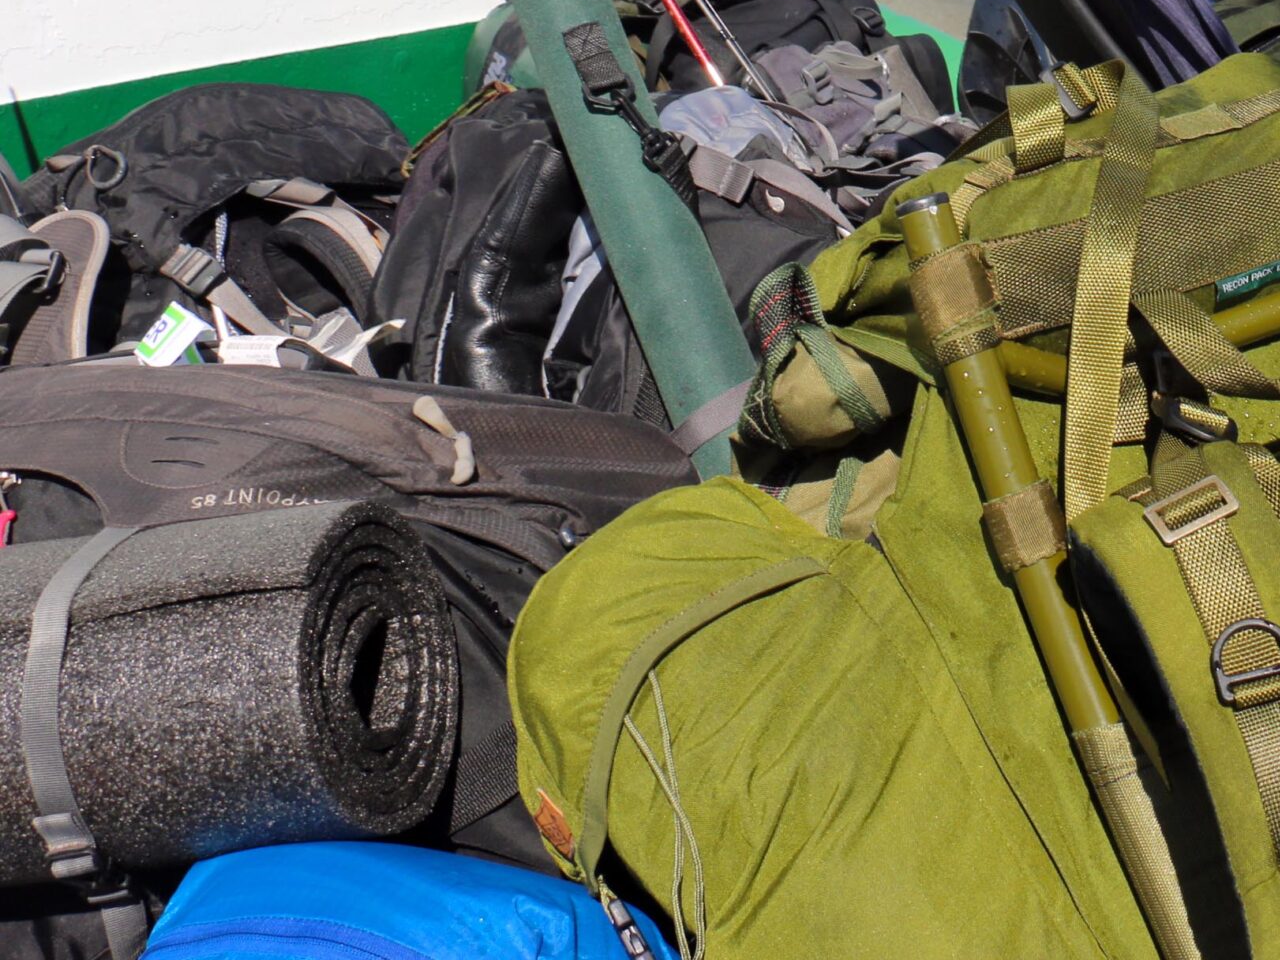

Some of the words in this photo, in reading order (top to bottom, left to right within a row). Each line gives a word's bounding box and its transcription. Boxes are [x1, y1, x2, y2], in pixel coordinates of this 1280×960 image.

[1222, 275, 1250, 294] RECON
[1251, 266, 1274, 283] PACK
[191, 494, 217, 509] 85
